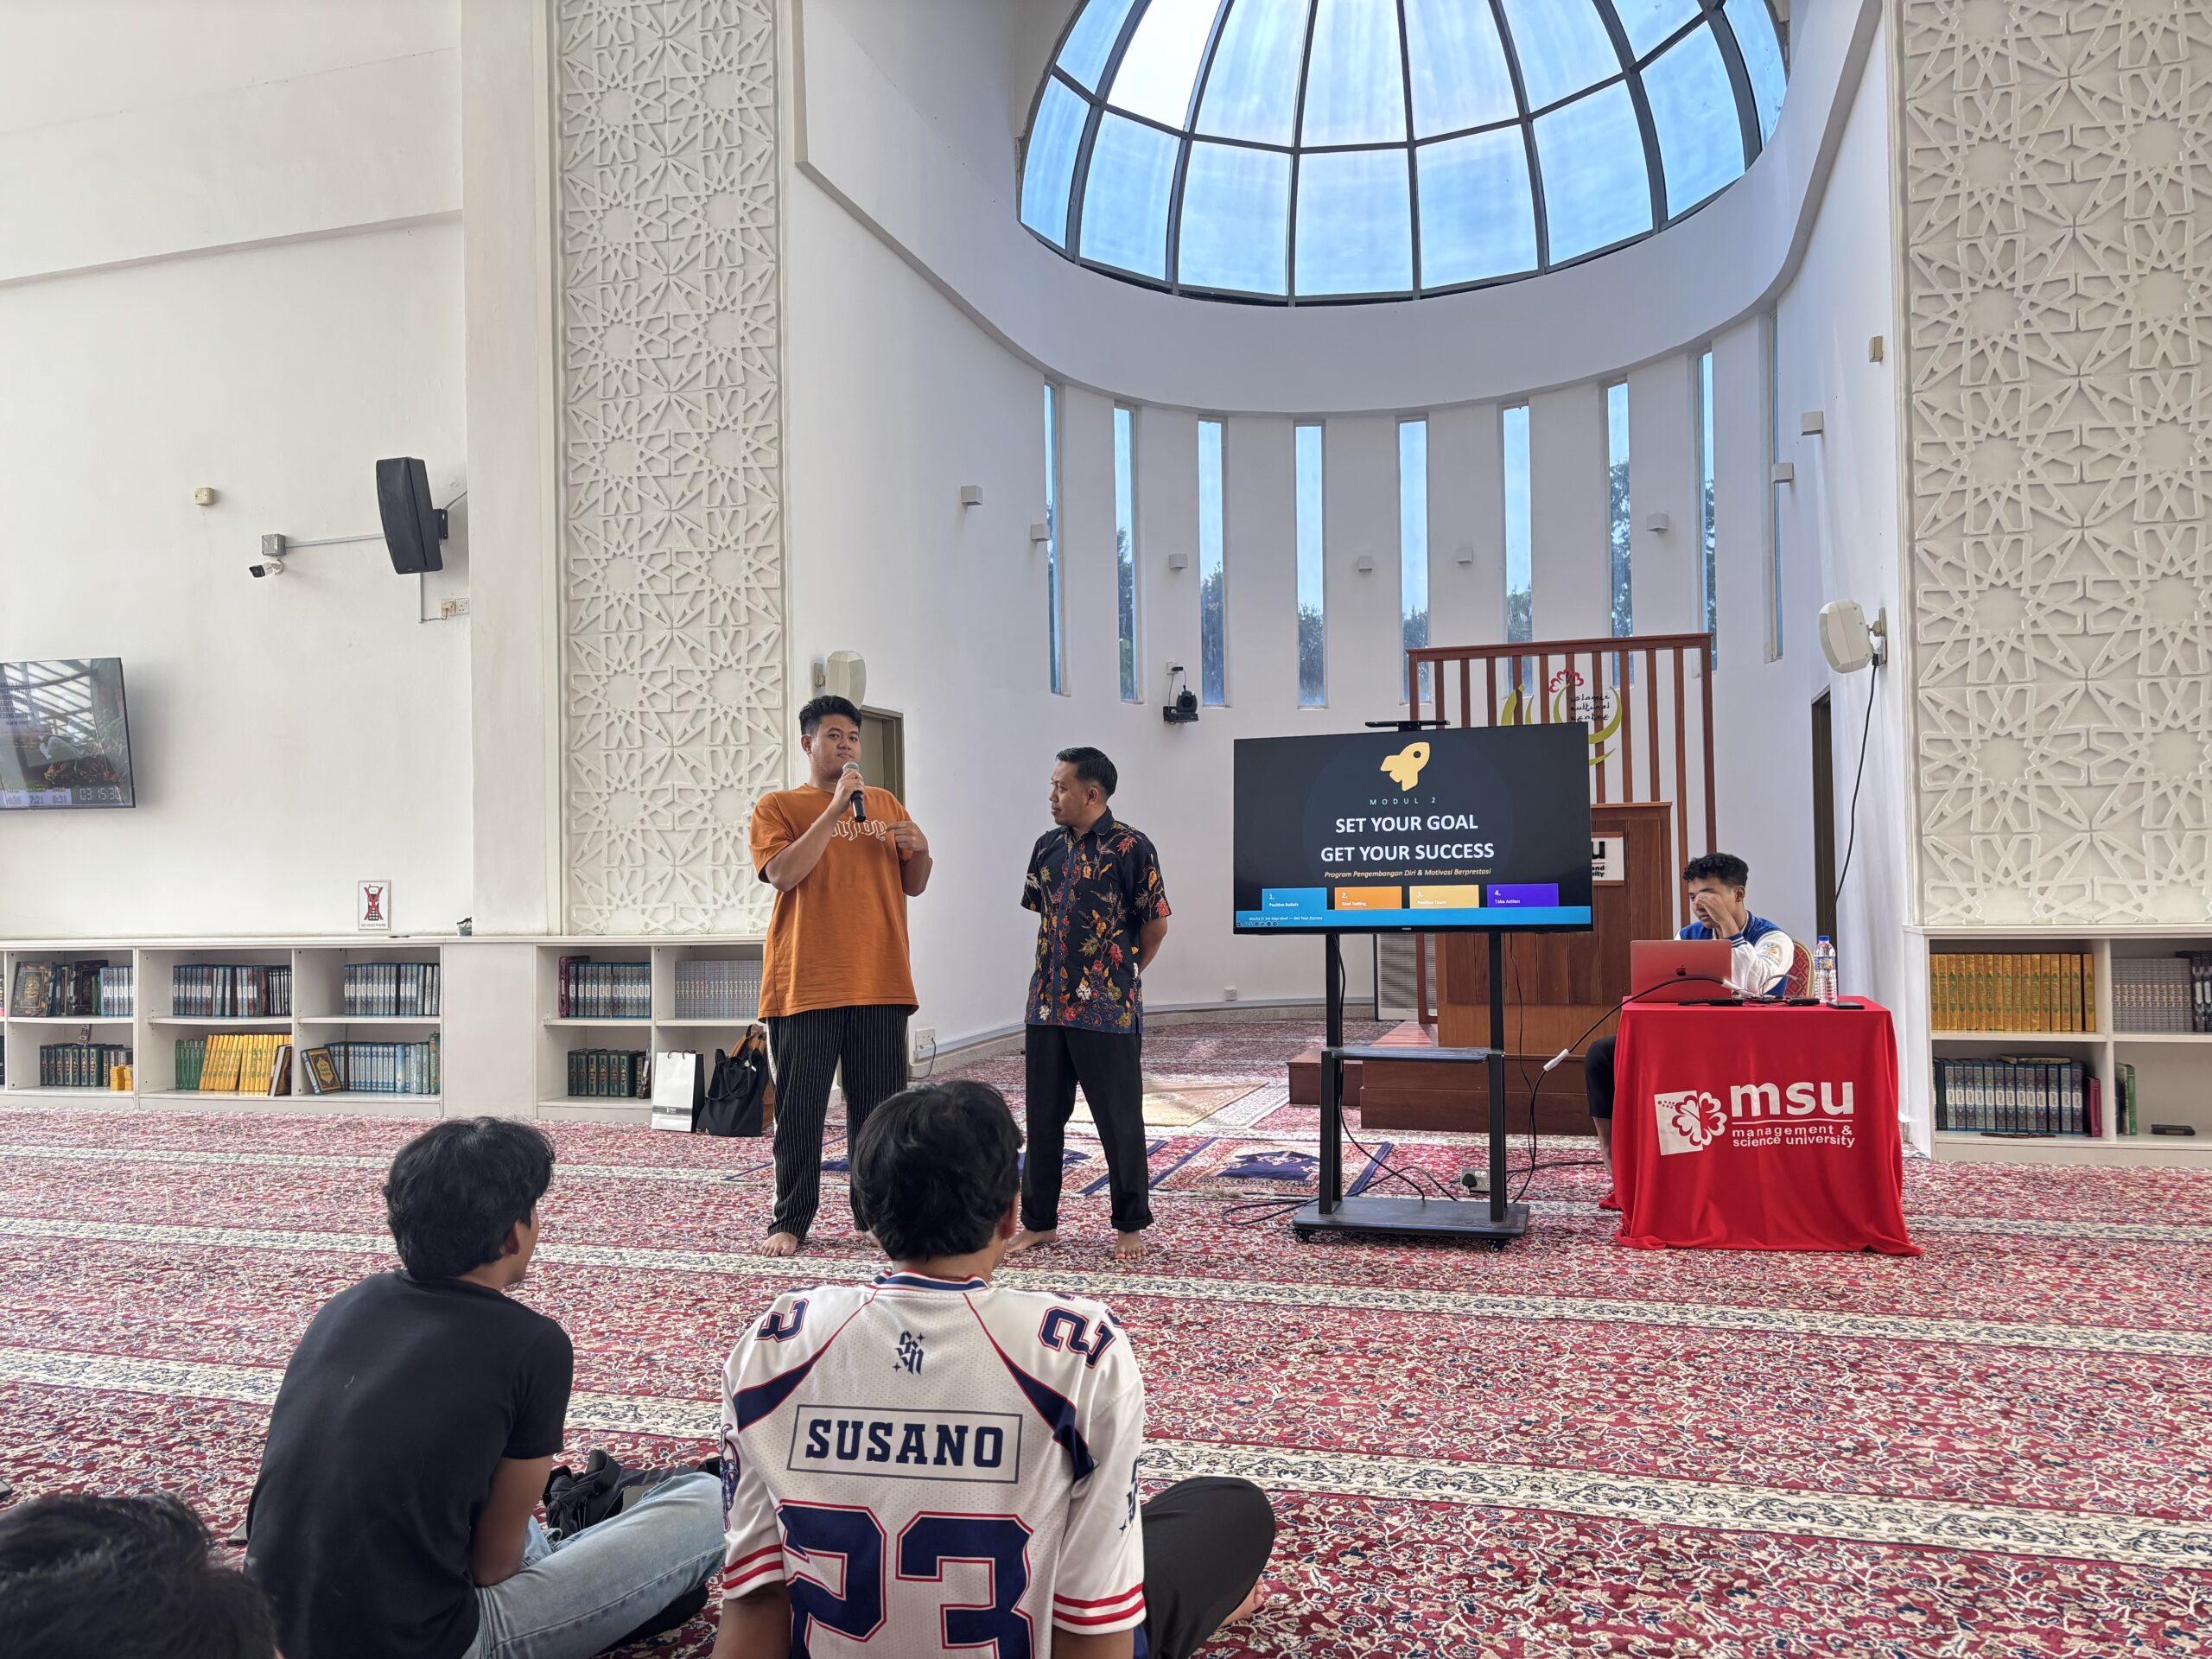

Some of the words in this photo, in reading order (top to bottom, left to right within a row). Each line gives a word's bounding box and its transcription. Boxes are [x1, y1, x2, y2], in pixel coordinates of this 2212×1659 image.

[1335, 818, 1366, 833] SET
[1370, 816, 1421, 832] YOUR
[1427, 814, 1478, 830] GOAL
[1320, 847, 1355, 861] GET
[1359, 845, 1410, 861] YOUR
[1415, 842, 1495, 860] SUCCESS
[1325, 871, 1351, 880] Program
[1352, 870, 1403, 879] Pengembangan
[1454, 868, 1491, 877] Berprestasi
[1730, 1082, 1854, 1117] msu
[1732, 1124, 1834, 1138] management
[1841, 1125, 1853, 1135] &
[1732, 1135, 1781, 1147] science
[1786, 1135, 1855, 1147] university
[804, 1418, 1004, 1468] SUSANO
[777, 1499, 1035, 1659] 23
